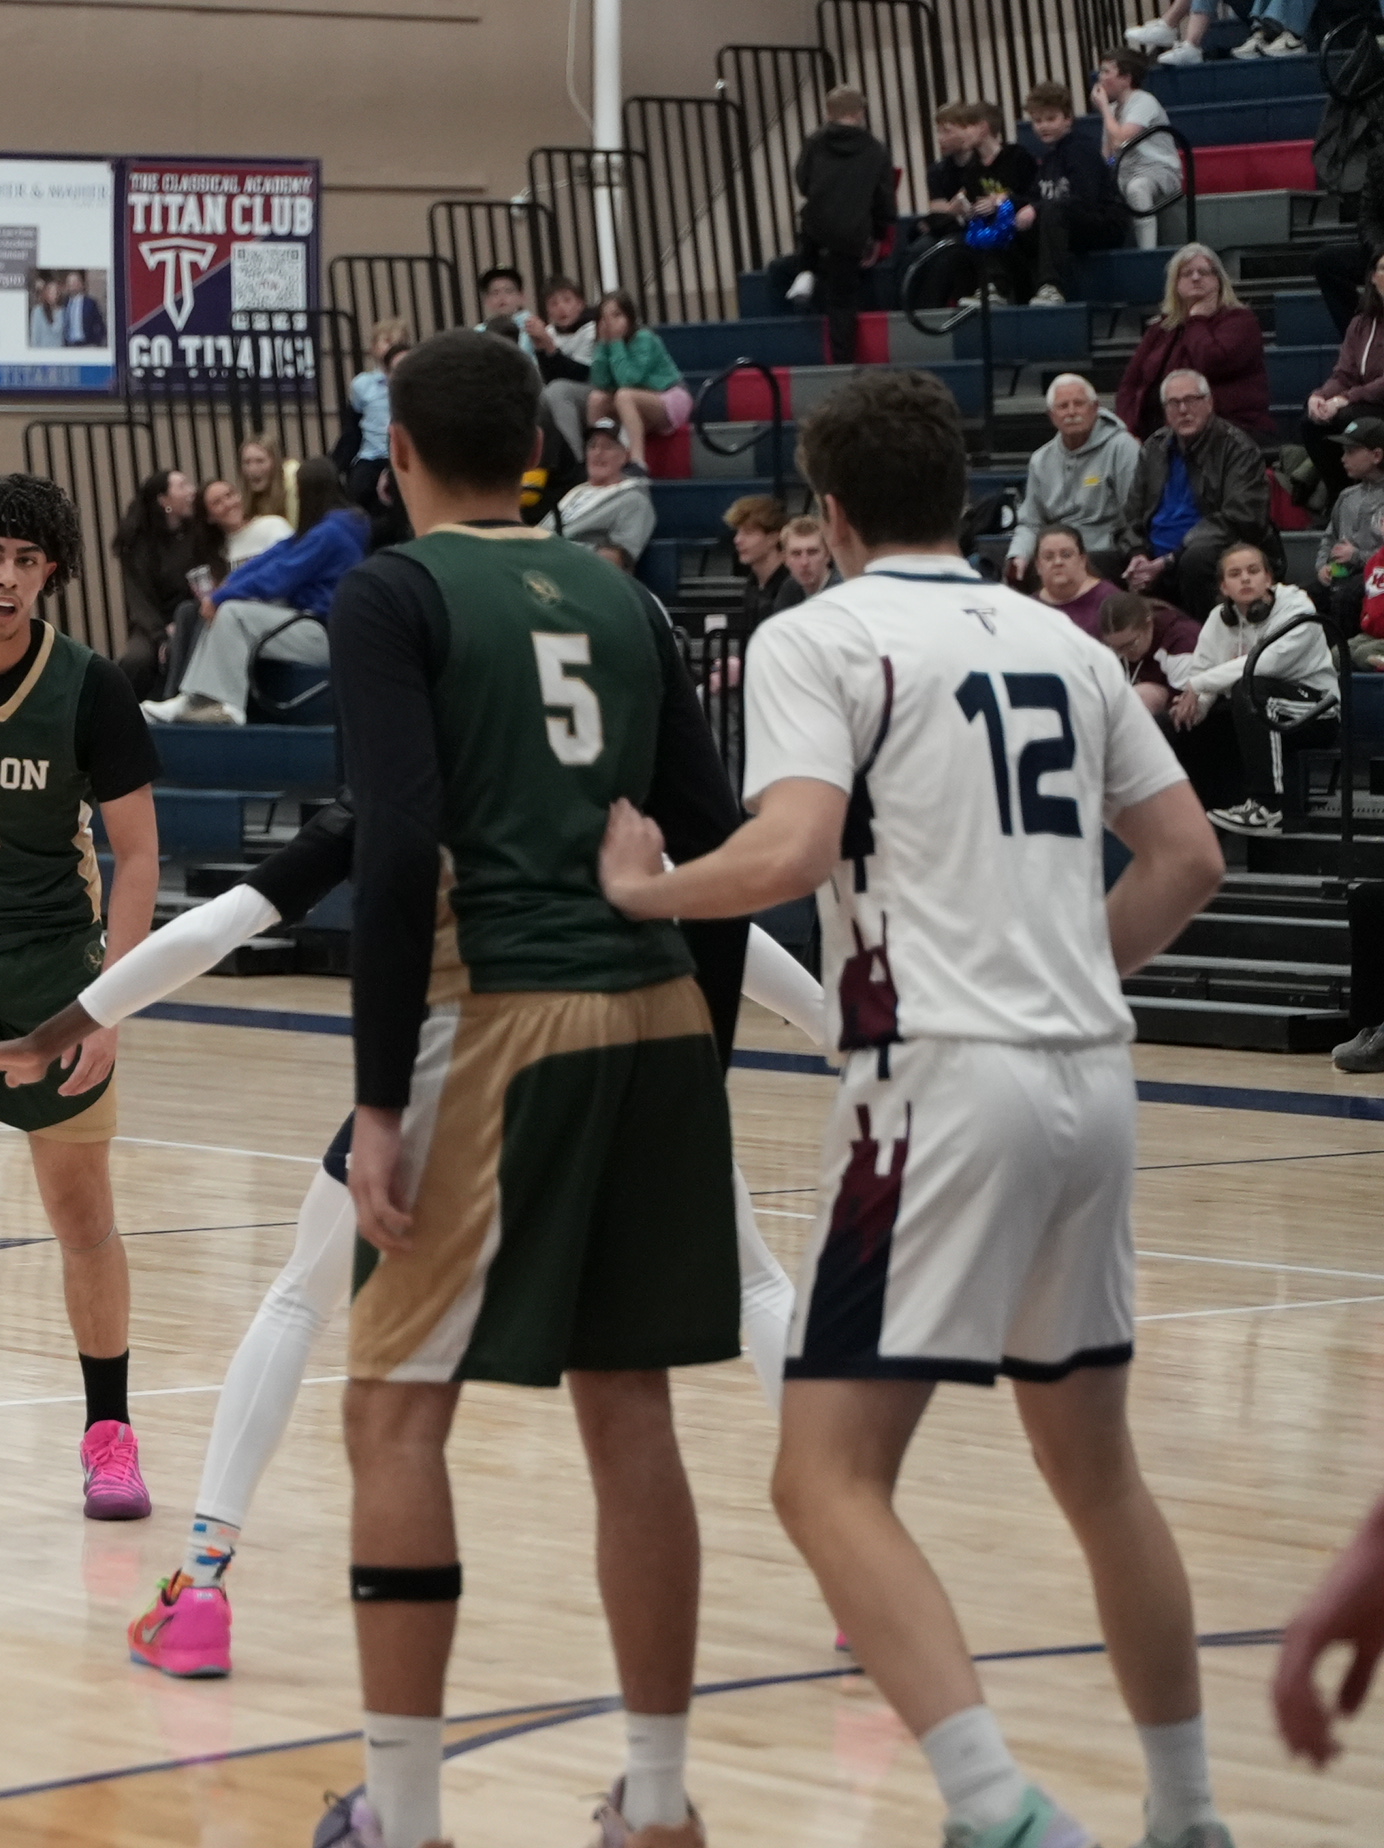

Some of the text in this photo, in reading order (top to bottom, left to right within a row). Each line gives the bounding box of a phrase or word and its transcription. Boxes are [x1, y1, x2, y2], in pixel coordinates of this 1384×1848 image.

[127, 192, 314, 236] TITAN CLUB
[129, 172, 314, 195] THE CLASSICAL ACADEMY
[530, 630, 605, 765] 5
[953, 670, 1084, 839] 12
